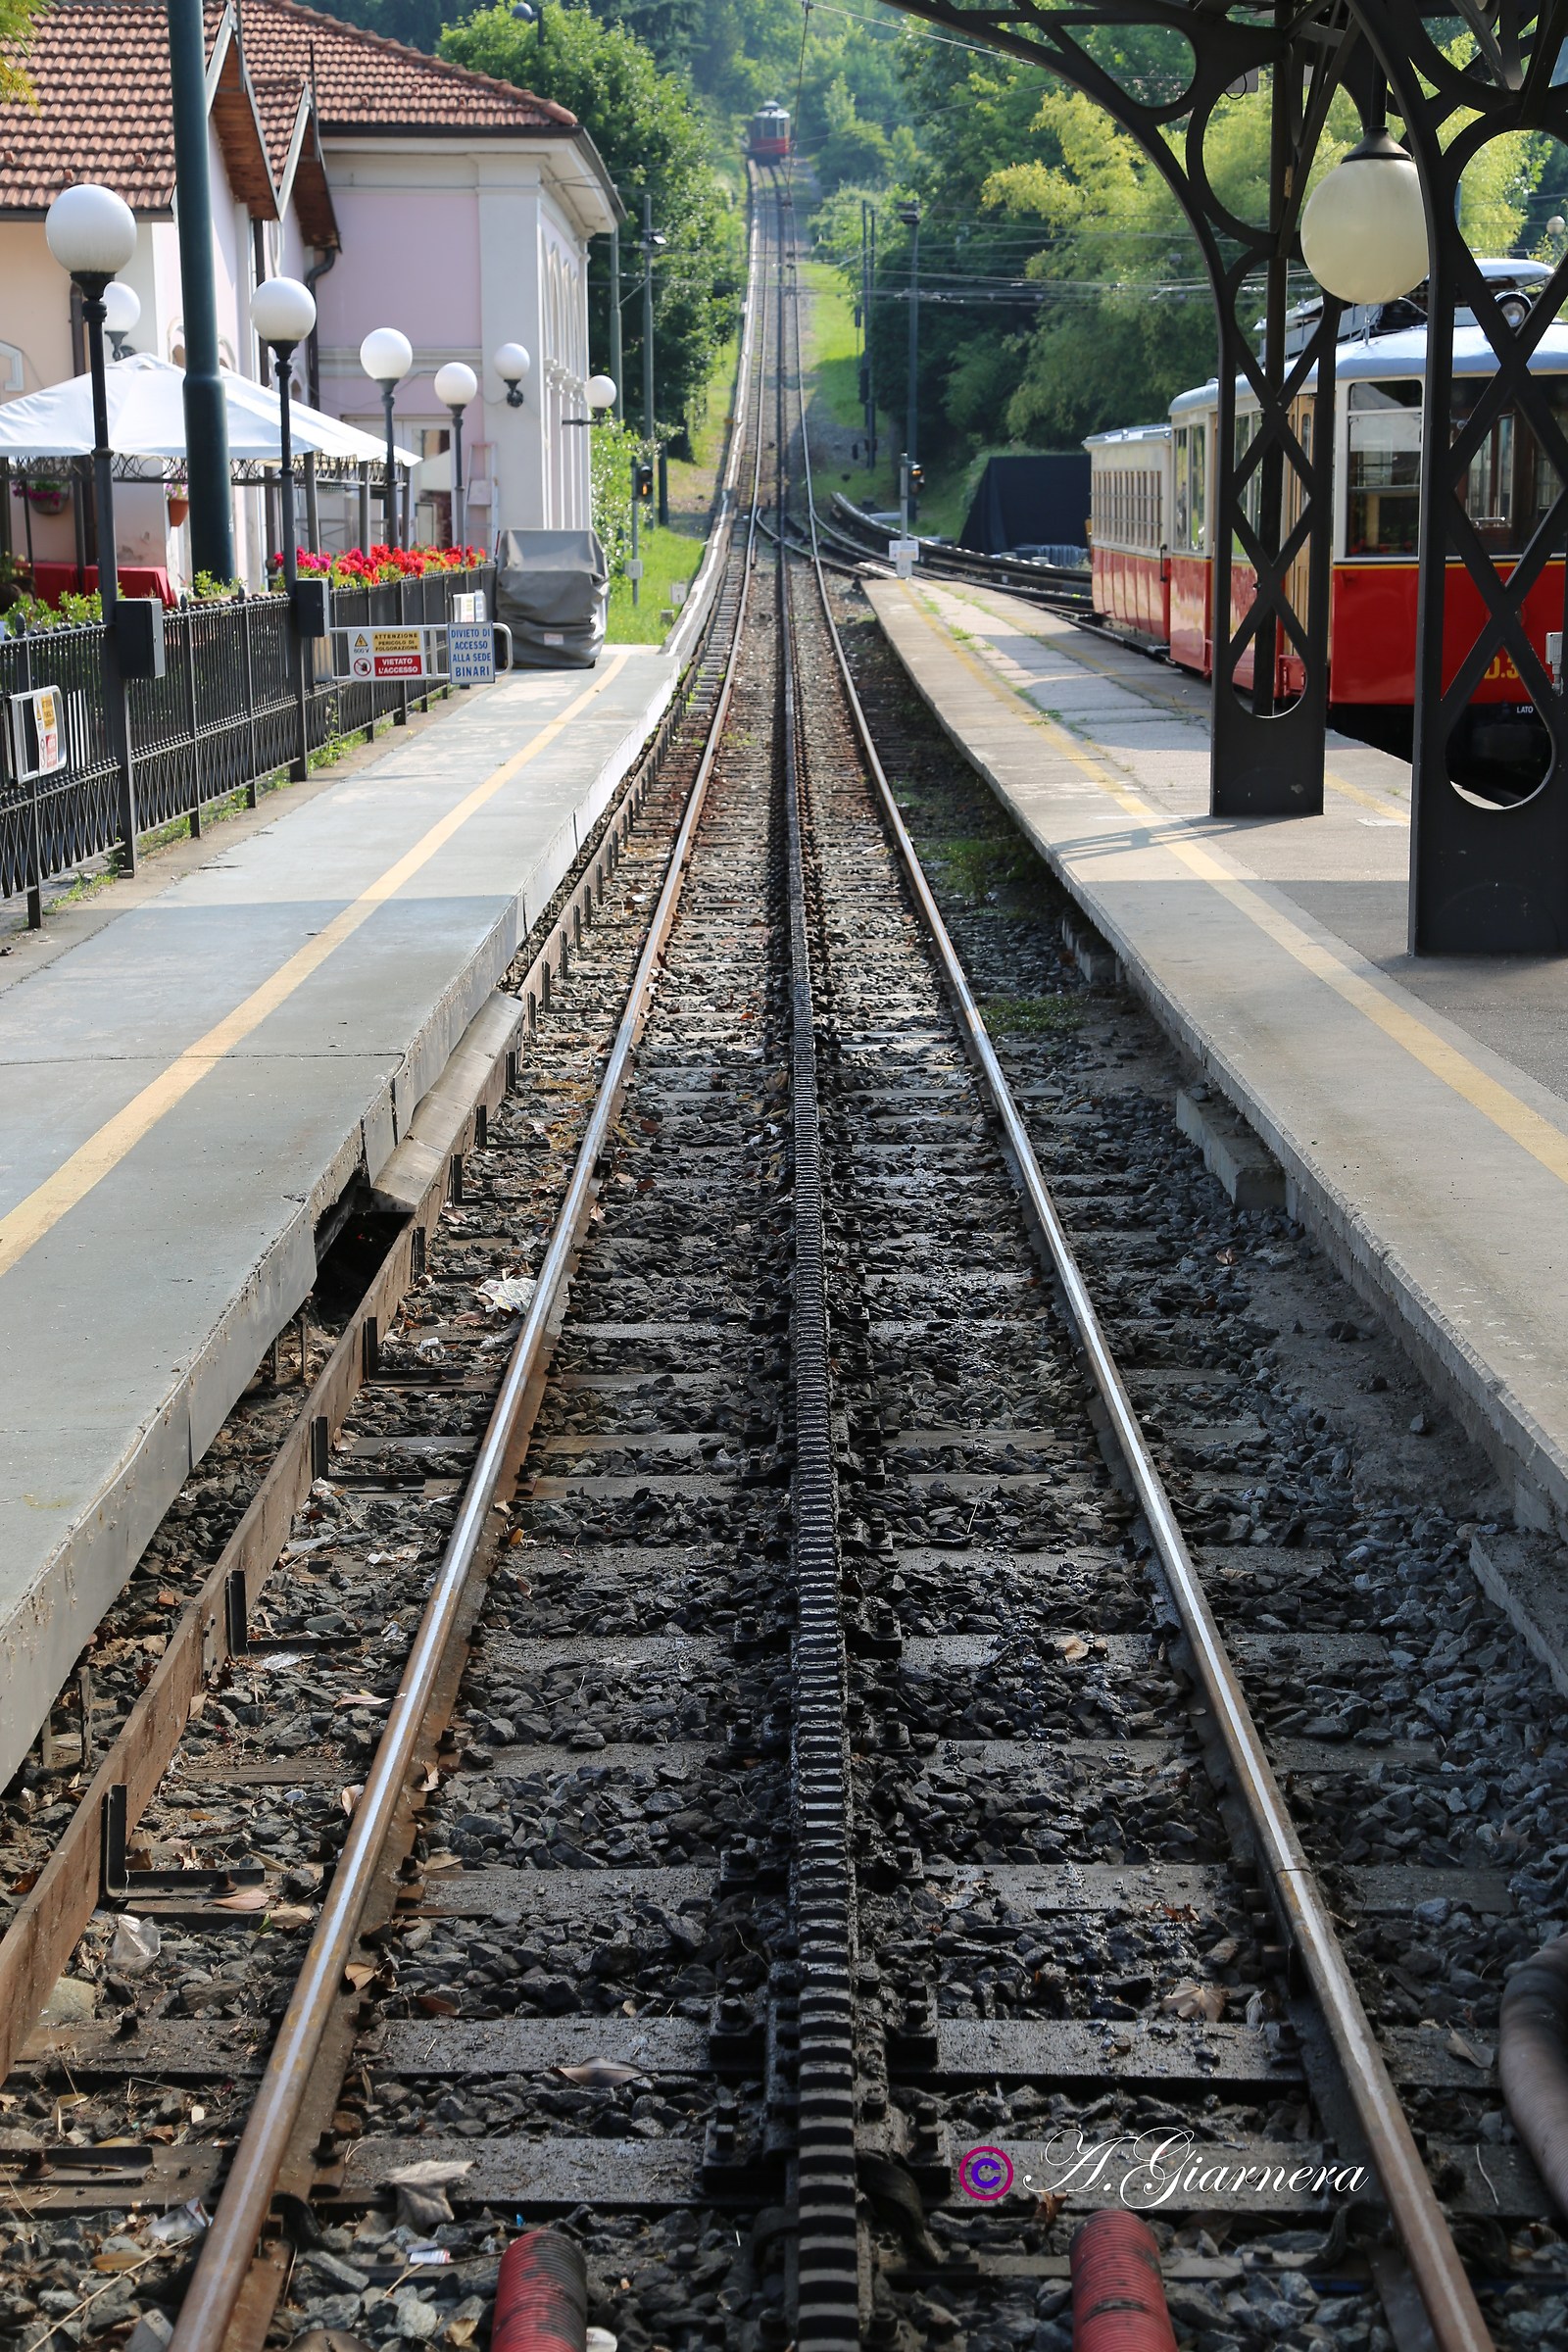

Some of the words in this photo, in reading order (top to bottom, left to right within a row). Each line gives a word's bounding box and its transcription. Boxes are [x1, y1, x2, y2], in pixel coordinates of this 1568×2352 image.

[451, 629, 479, 639] DIVIETO
[482, 628, 490, 637] DI
[455, 640, 488, 650] ACCESSO
[452, 653, 470, 662] ALLA
[472, 652, 491, 662] SEDE
[455, 665, 490, 677] BINARI
